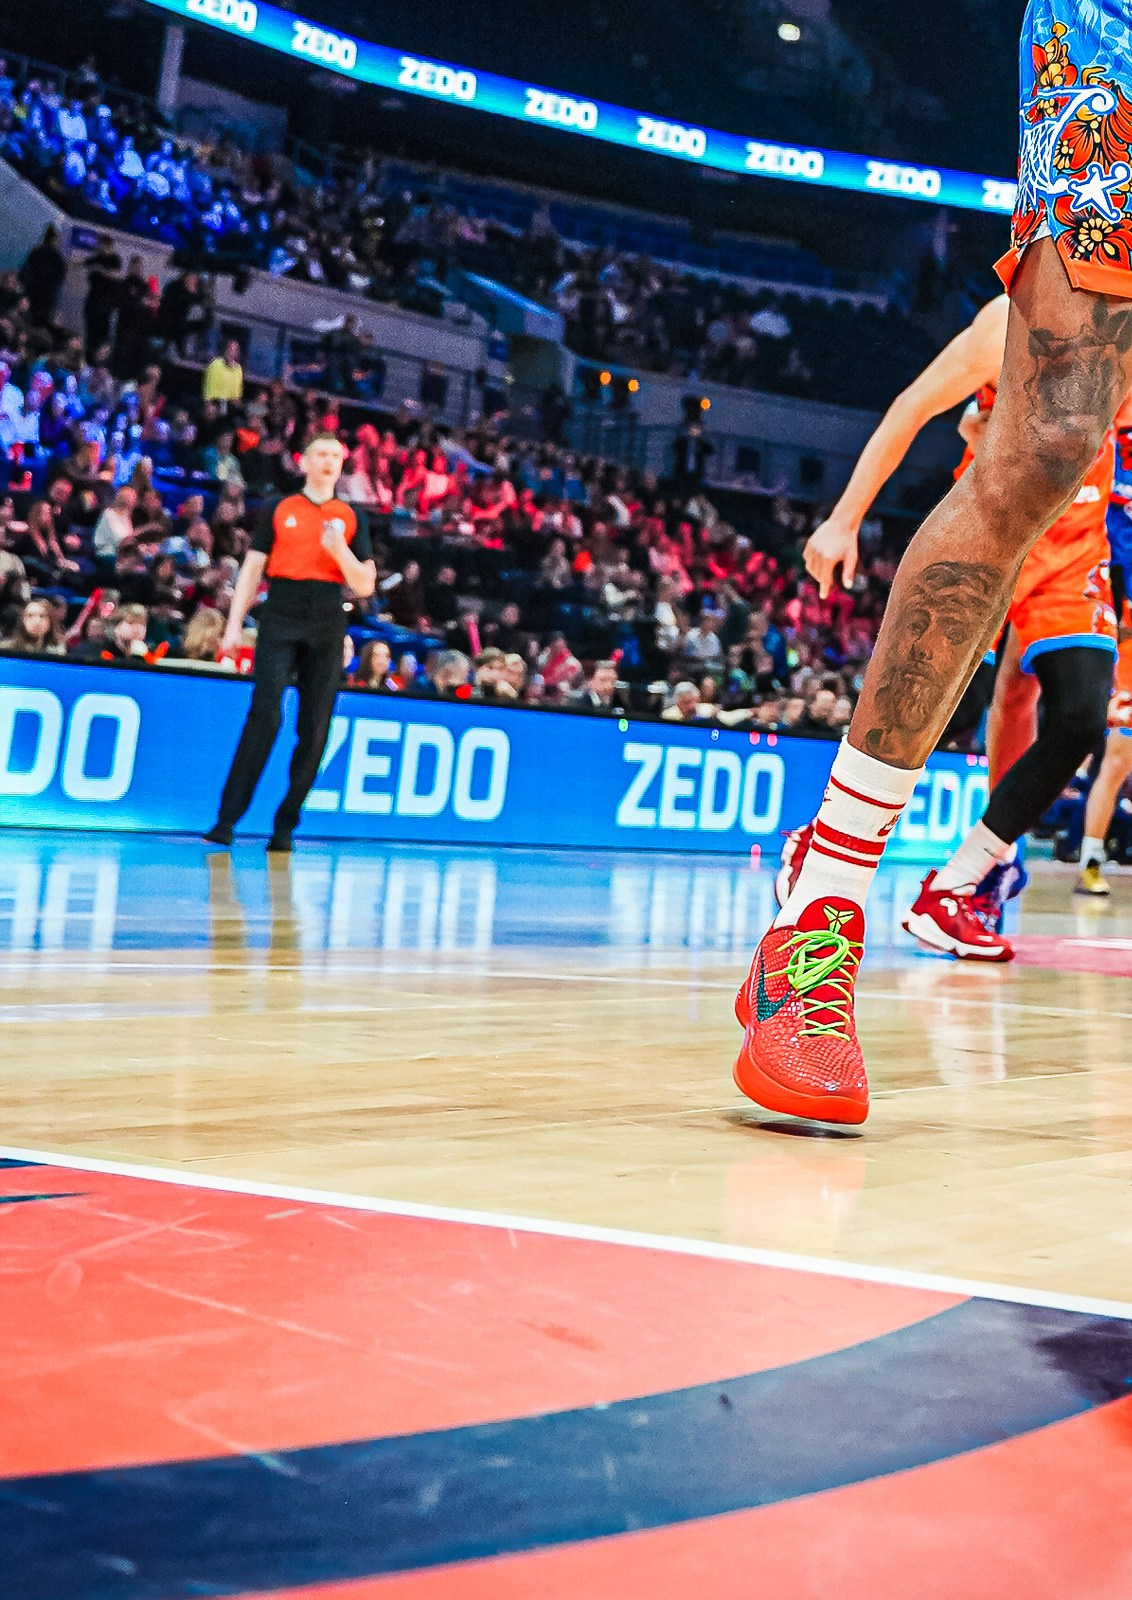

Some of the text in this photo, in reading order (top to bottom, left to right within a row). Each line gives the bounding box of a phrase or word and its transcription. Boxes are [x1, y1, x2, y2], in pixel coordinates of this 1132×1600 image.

[292, 21, 357, 69] ZEDO
[398, 56, 476, 101] ZEDO
[525, 88, 598, 131] ZEDO
[637, 116, 706, 158] ZEDO
[745, 142, 824, 178] ZEDO
[866, 161, 941, 197] ZEDO
[616, 742, 786, 834] ZEDO
[893, 770, 991, 840] EDO
